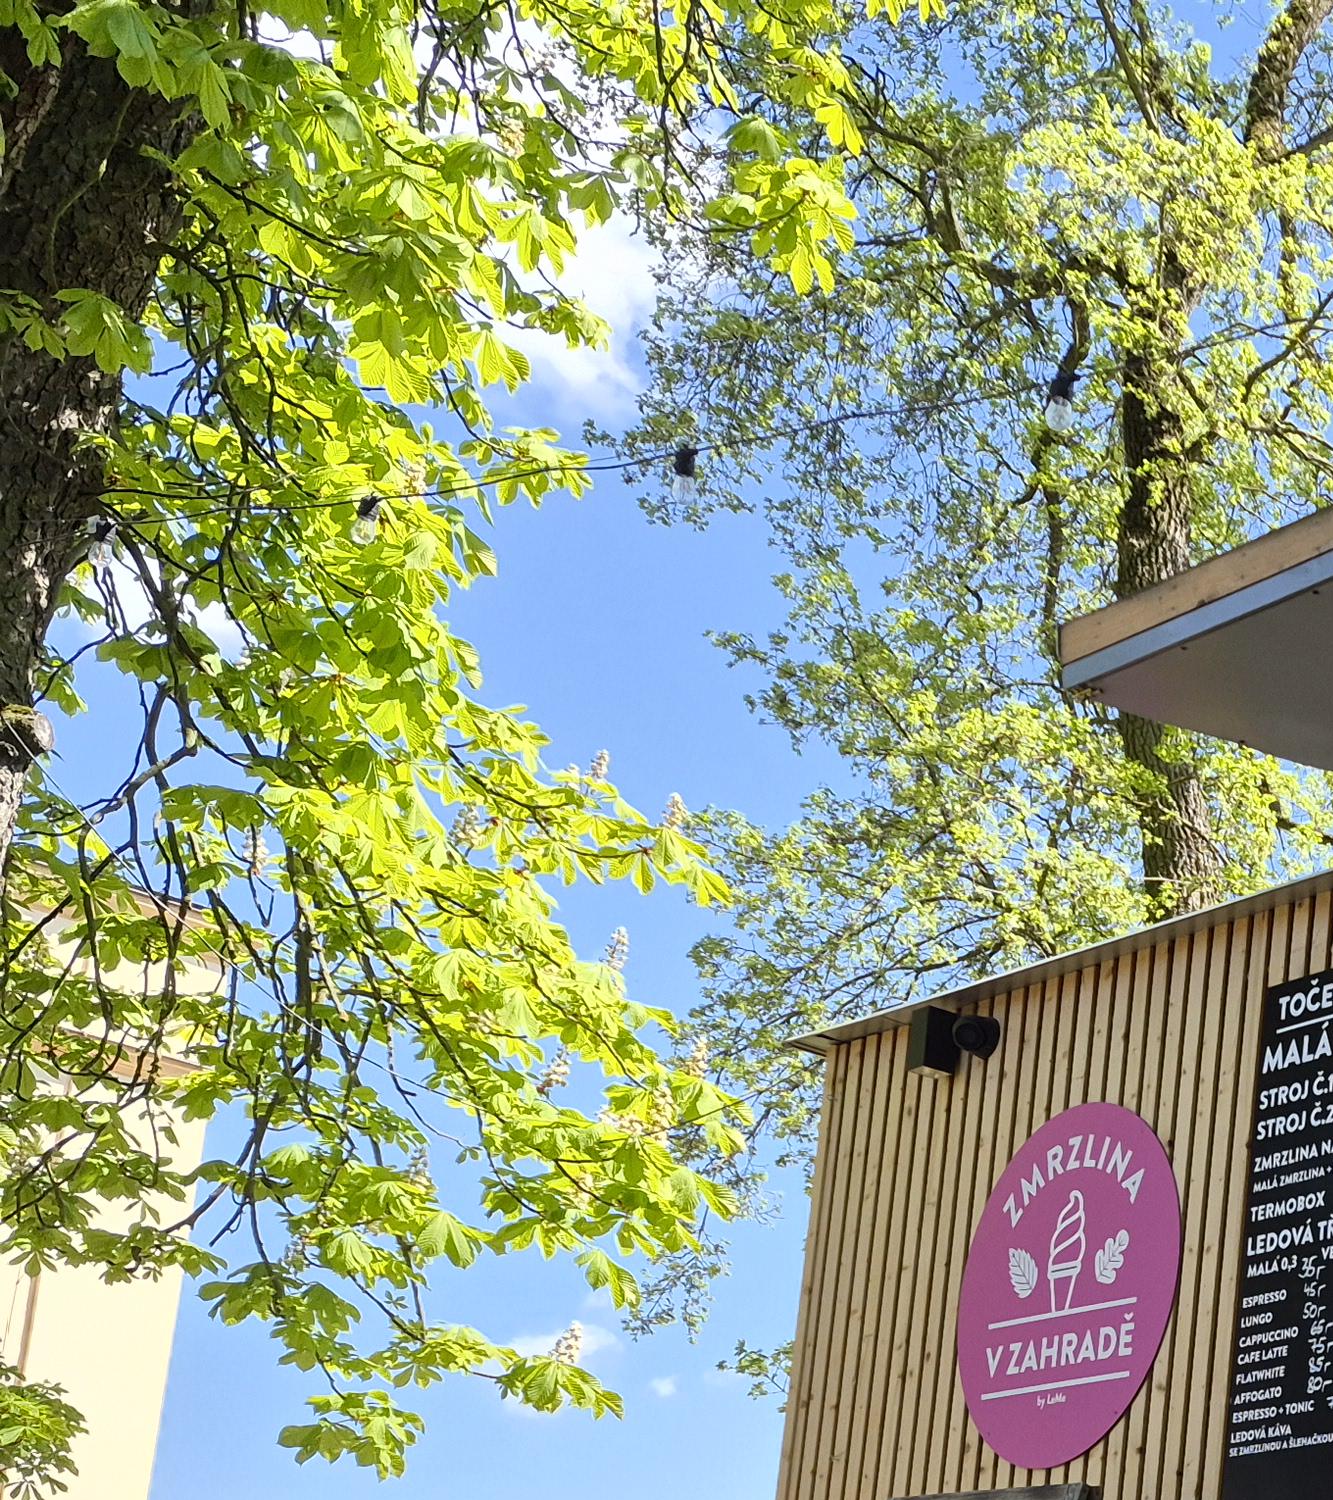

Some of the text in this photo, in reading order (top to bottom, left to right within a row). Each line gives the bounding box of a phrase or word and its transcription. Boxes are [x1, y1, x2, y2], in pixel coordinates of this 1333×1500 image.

[1262, 1021, 1332, 1074] MALÁ
[1259, 1079, 1309, 1110] STROJ
[1256, 1109, 1306, 1140] STROJ
[1254, 1143, 1318, 1173] ZMRZLINA
[1002, 1134, 1145, 1228] ZMRZLINA
[1253, 1174, 1278, 1193] MALÁ
[1279, 1166, 1325, 1186] ZMRZLINA
[1250, 1191, 1326, 1223] TERMOBOX
[1247, 1218, 1314, 1256] LEDOVÁ
[1247, 1255, 1280, 1278] MALÁ
[1281, 1255, 1297, 1272] 0,3
[1242, 1289, 1287, 1308] ESPRESSO
[1241, 1312, 1273, 1328] LUNGO
[986, 1312, 1135, 1378] V ZAHRADĚ
[1239, 1326, 1299, 1348] CAPPUCCINO
[1262, 1345, 1288, 1360] LATTE
[1236, 1366, 1286, 1385] FLATWHITE
[1234, 1386, 1282, 1405] AFFOGATO
[1232, 1407, 1277, 1424] ESPRESSO
[1285, 1400, 1315, 1415] TONIC
[1230, 1423, 1292, 1443] LEDOVÁ KÁVA
